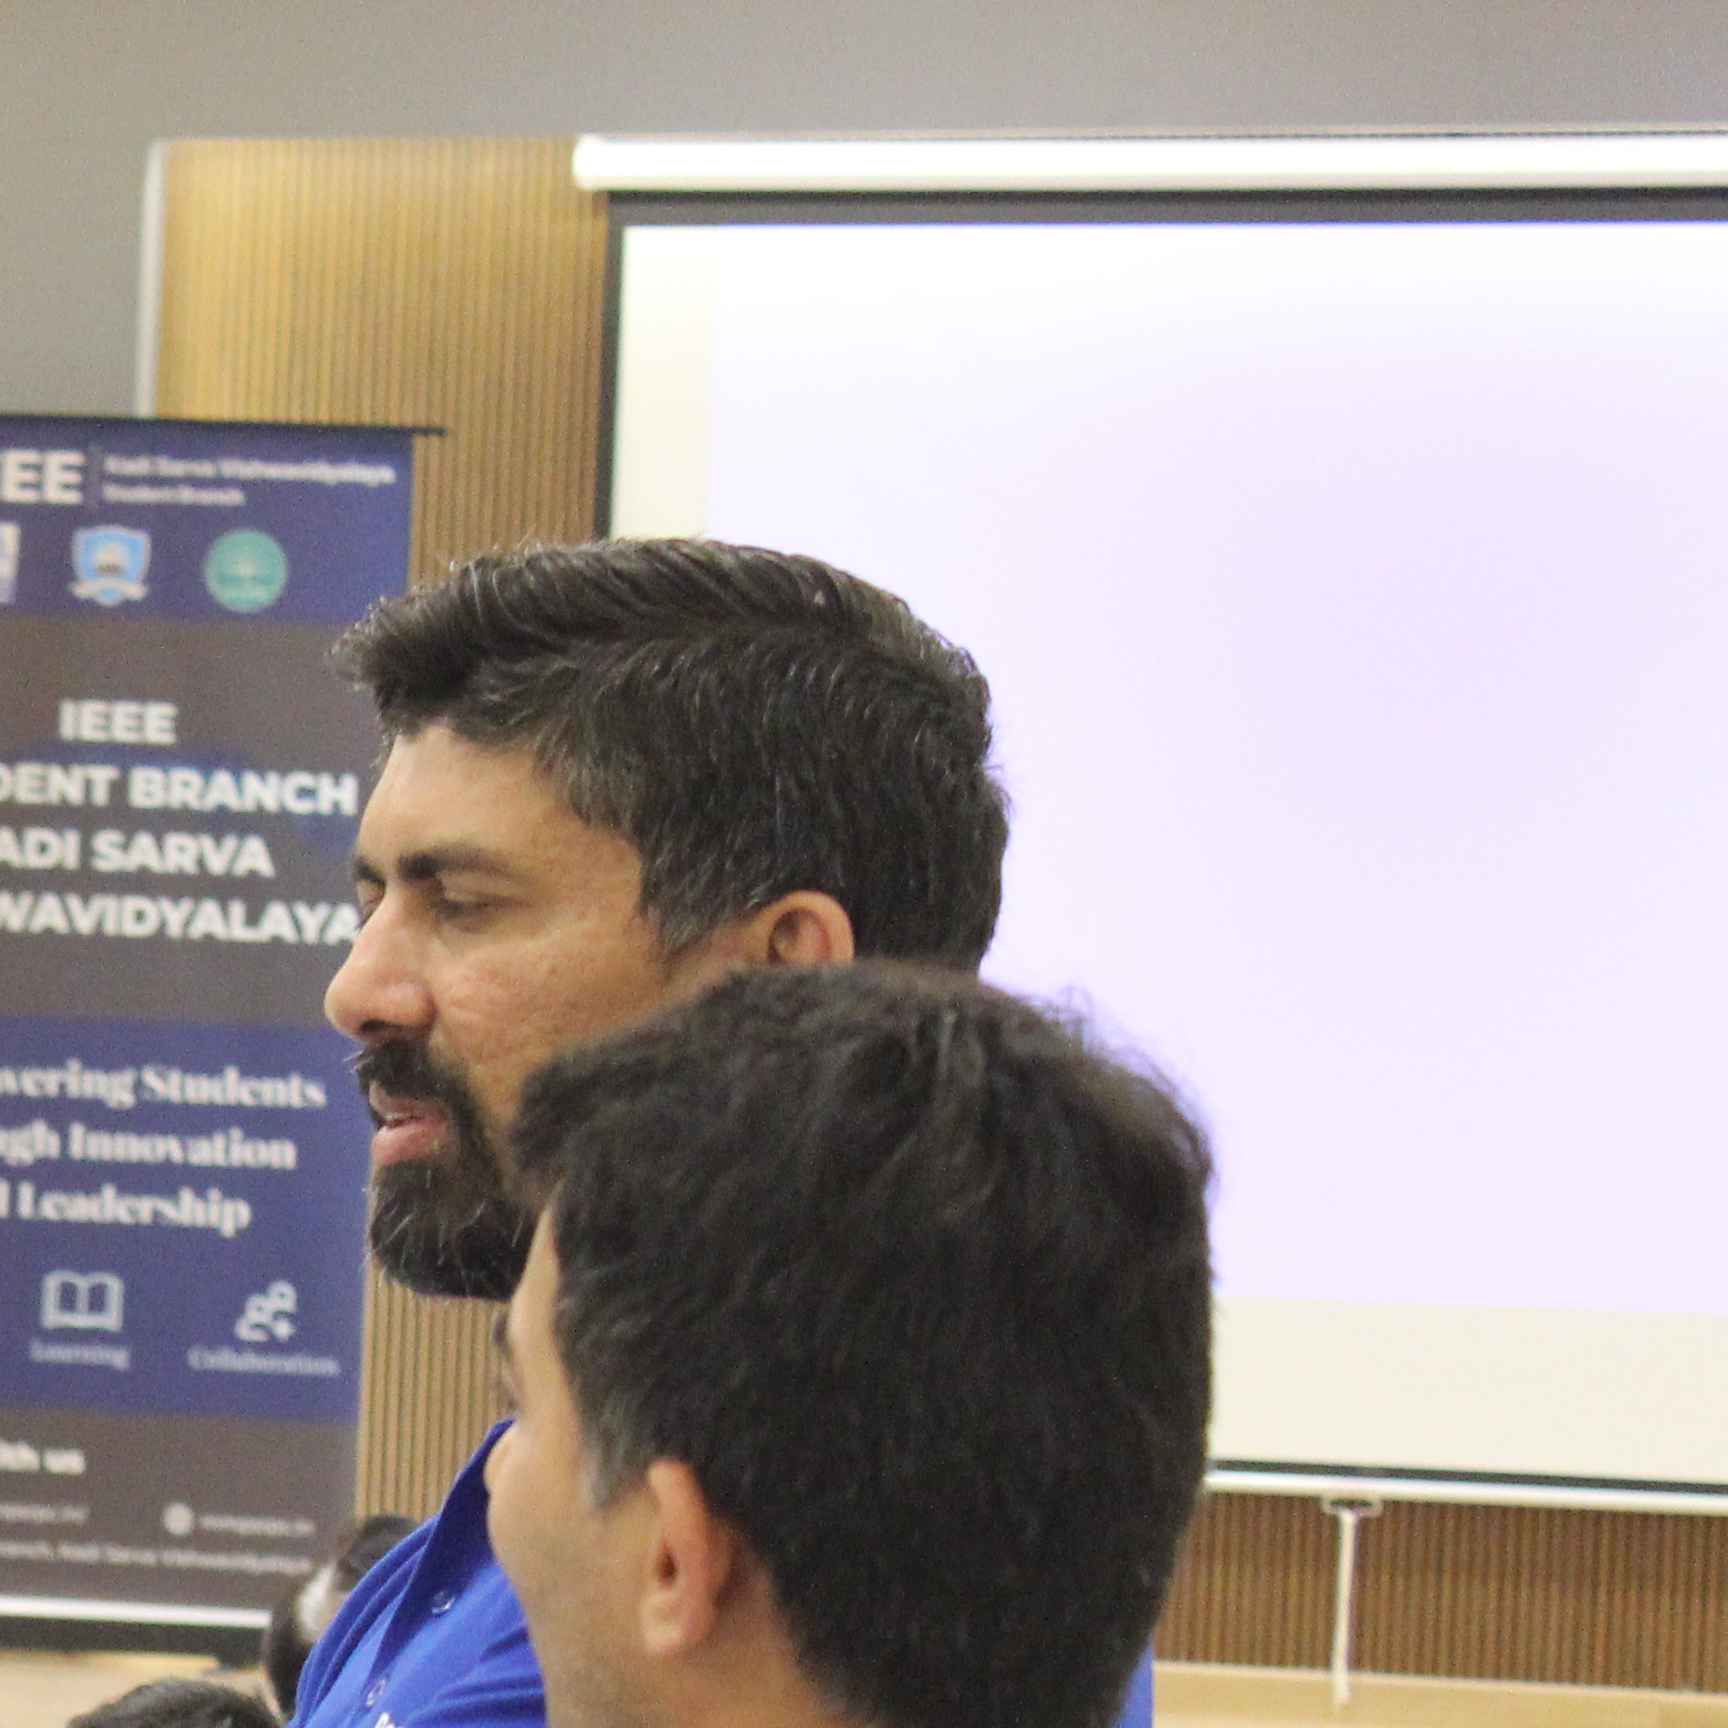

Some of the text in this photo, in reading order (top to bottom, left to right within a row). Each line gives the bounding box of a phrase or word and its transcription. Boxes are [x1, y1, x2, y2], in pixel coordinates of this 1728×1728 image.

[59, 700, 177, 745] IEEE
[129, 767, 358, 816] BRANCH
[91, 829, 275, 877] SARVA
[141, 1066, 327, 1108] Students
[69, 1122, 297, 1170] Innovation
[17, 1181, 252, 1238] Leadership
